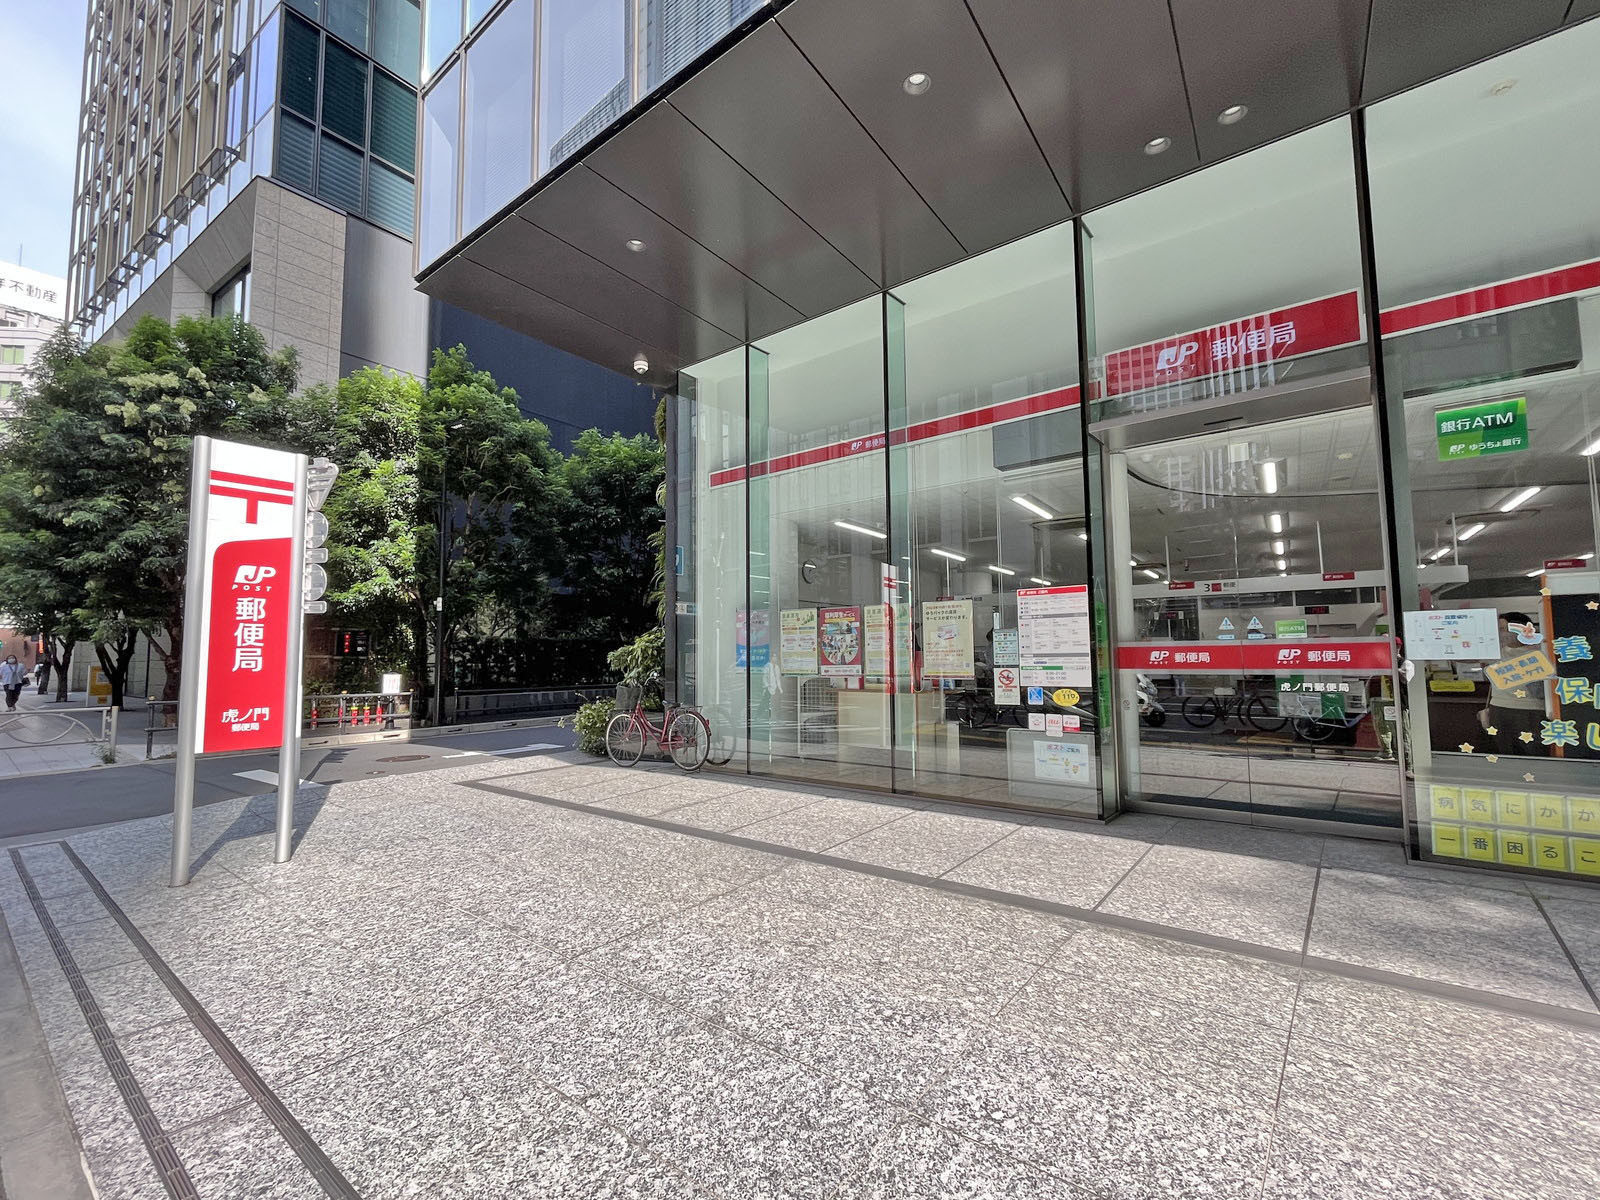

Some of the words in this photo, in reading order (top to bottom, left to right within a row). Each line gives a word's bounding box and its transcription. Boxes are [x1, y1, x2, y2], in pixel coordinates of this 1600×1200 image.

[1211, 321, 1297, 361] 郵便局
[1155, 365, 1196, 378] POST
[1441, 412, 1514, 433] 銀行ATM
[1469, 437, 1521, 451] ゆうちょ銀行
[232, 585, 273, 593] POST
[1203, 583, 1211, 592] 3
[232, 596, 266, 673] 郵便局
[1174, 652, 1211, 663] 郵便局
[1307, 650, 1351, 662] 郵便局
[1280, 682, 1350, 692] 虎ノ門郵便局
[1557, 679, 1600, 709] 保
[221, 707, 270, 724] 虎ノ門
[231, 722, 260, 733] 郵便局
